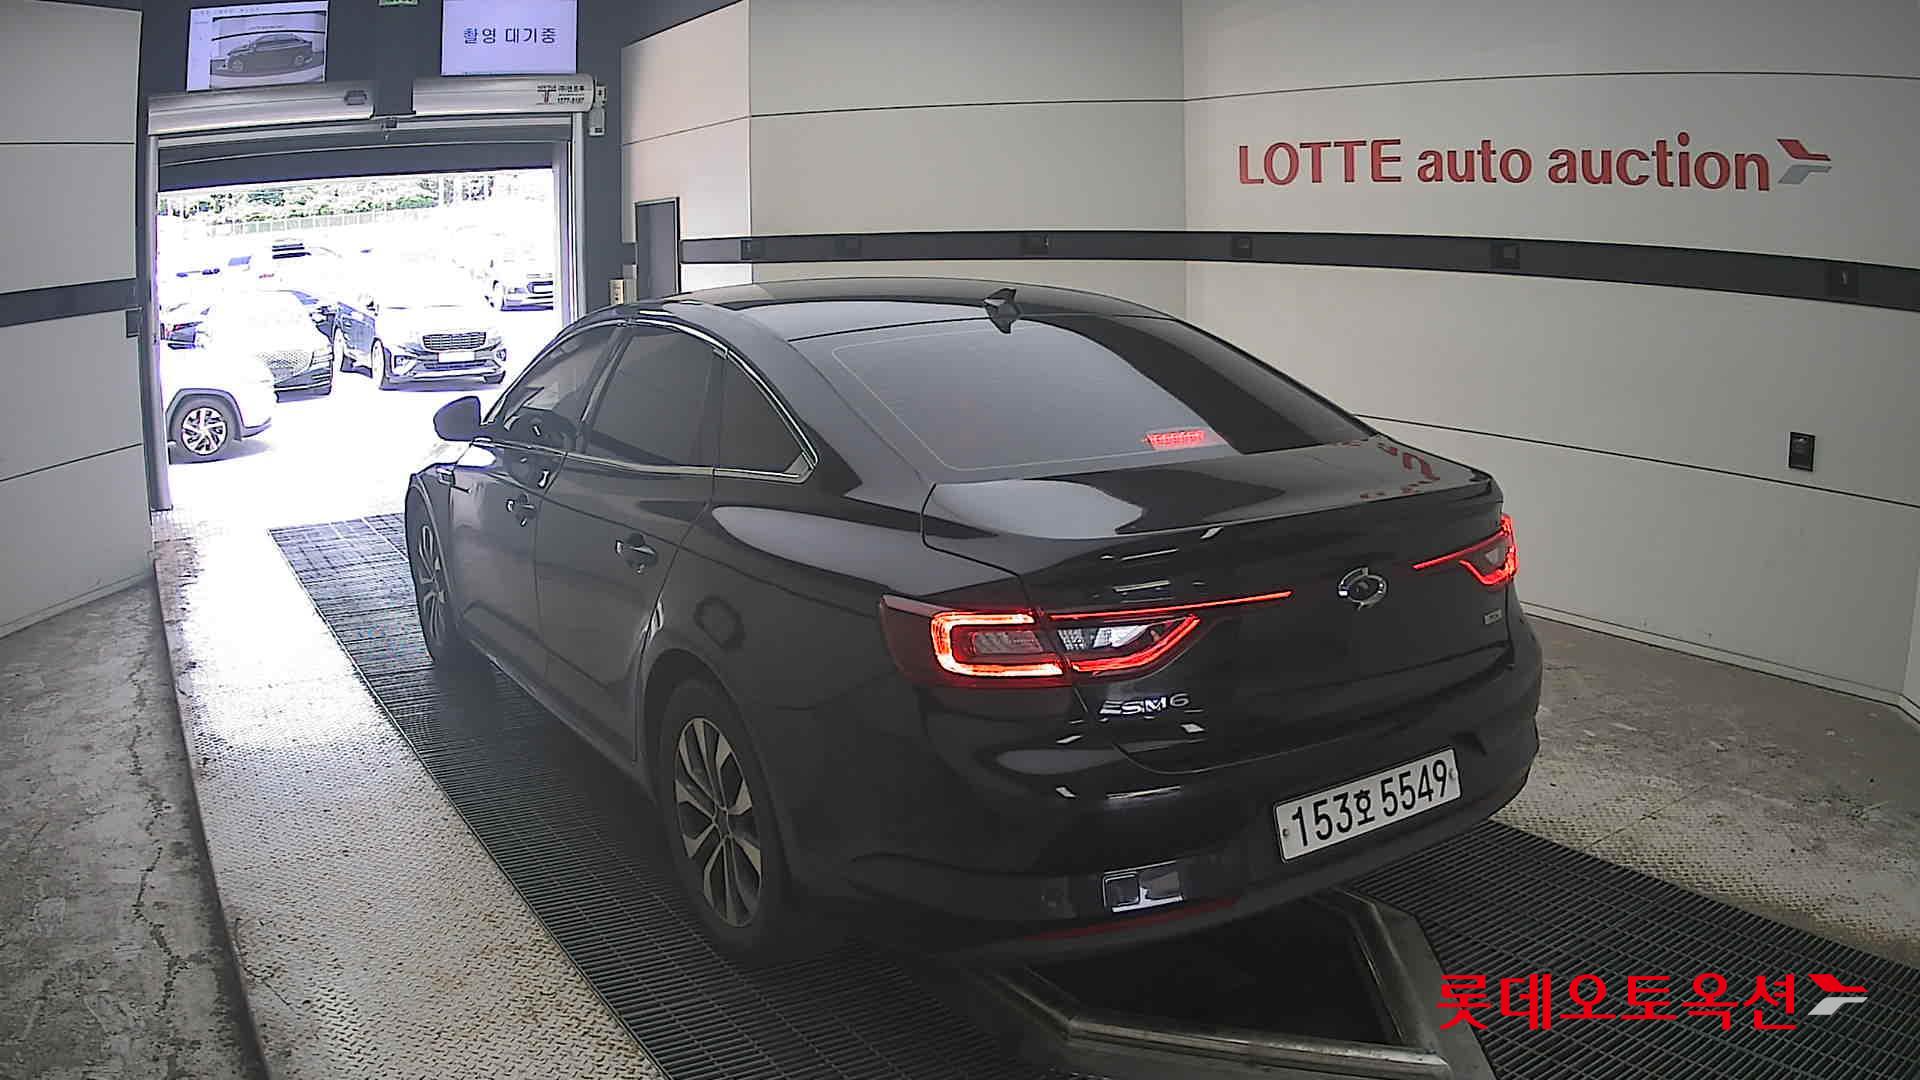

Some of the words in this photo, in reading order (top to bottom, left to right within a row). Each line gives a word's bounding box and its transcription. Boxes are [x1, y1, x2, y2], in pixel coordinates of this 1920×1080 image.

[463, 27, 496, 45] 촬영
[505, 27, 556, 45] 대기중
[1238, 138, 1402, 186] LOTTE
[1416, 139, 1533, 184] auto
[1547, 131, 1770, 191] auction
[1291, 788, 1376, 847] 153호
[1380, 758, 1448, 818] 5549
